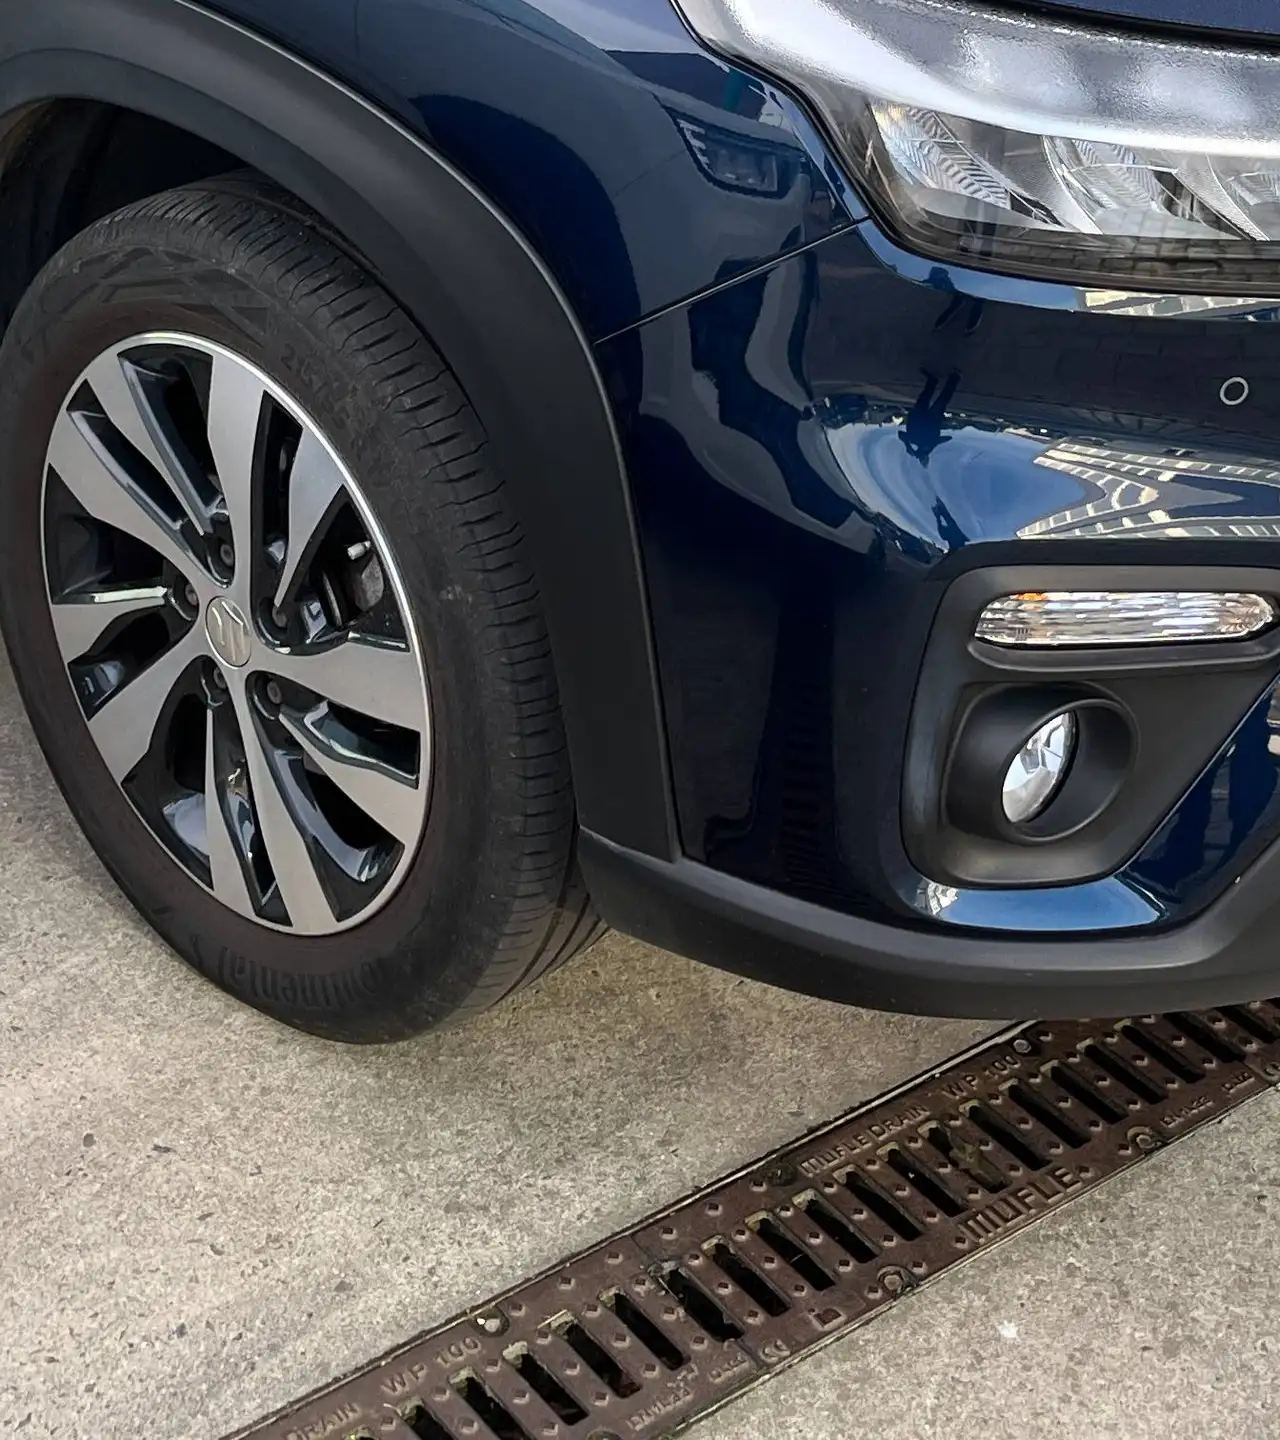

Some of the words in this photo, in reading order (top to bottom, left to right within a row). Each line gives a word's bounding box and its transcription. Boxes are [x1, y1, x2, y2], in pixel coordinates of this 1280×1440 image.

[217, 946, 382, 1010] ontinental
[800, 1132, 873, 1177] MUFLE
[868, 1104, 933, 1142] DRAIN
[941, 1074, 979, 1101] WP
[957, 1165, 1083, 1246] MUFLE
[380, 1363, 429, 1398] WP
[436, 1335, 483, 1369] 100
